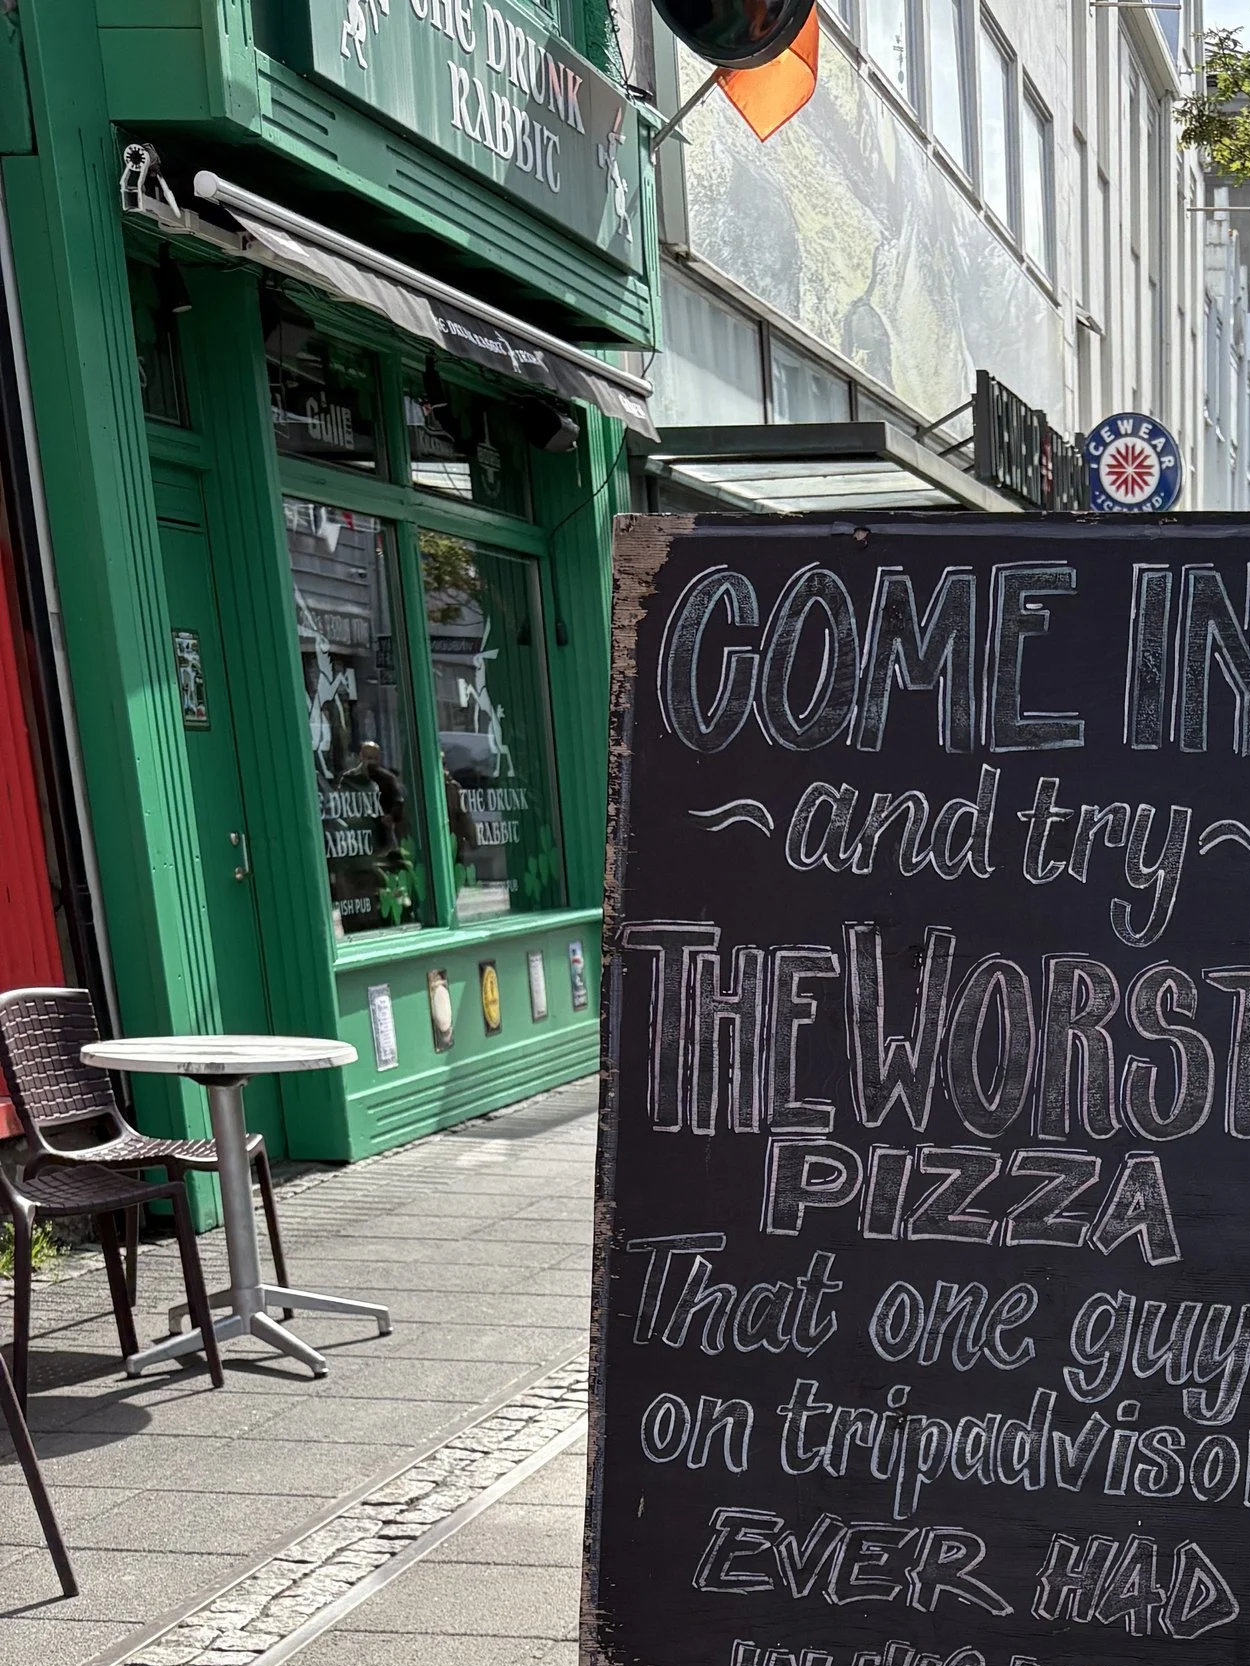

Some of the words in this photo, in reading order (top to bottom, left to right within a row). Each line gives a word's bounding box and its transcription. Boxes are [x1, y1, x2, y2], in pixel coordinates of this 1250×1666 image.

[447, 60, 560, 193] RABBIT
[483, 1, 586, 135] DRUNK
[1089, 419, 1175, 470] ICEWEAR
[657, 560, 1086, 755] COME
[326, 829, 374, 858] ABBIT
[329, 791, 384, 819] DRUNK
[459, 789, 484, 813] THE
[487, 788, 528, 812] DRUNK
[475, 821, 520, 846] RABBIT
[785, 764, 1000, 880] and
[1017, 777, 1193, 949] try
[355, 897, 372, 914] PUB
[615, 920, 840, 1135] THE
[759, 1135, 1183, 1268] PIZZA
[627, 1232, 843, 1357] That
[868, 1279, 1039, 1373] one
[640, 1392, 754, 1475] on
[692, 1506, 1014, 1617] EVER
[1030, 1532, 1240, 1640] HAD
